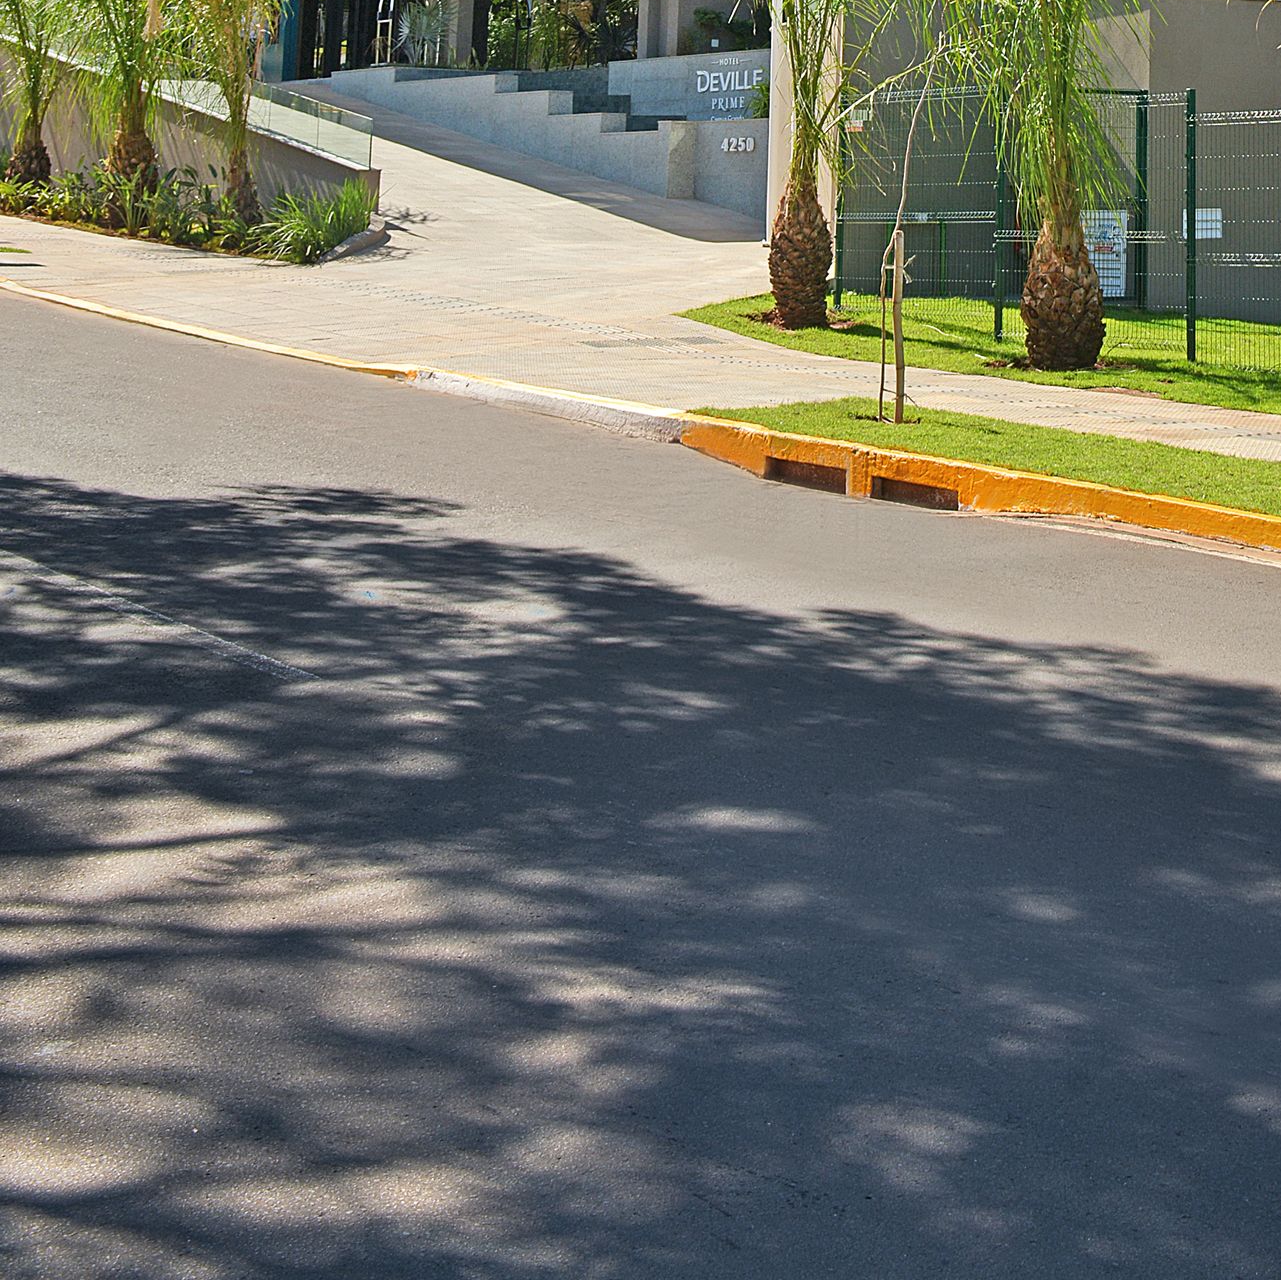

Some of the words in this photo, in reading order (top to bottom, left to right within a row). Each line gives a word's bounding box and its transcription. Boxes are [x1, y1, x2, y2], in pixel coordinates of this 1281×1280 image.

[719, 58, 739, 66] HOTEL
[696, 70, 763, 92] DEVILLE
[711, 96, 745, 111] PRIME
[721, 137, 755, 152] 4250
